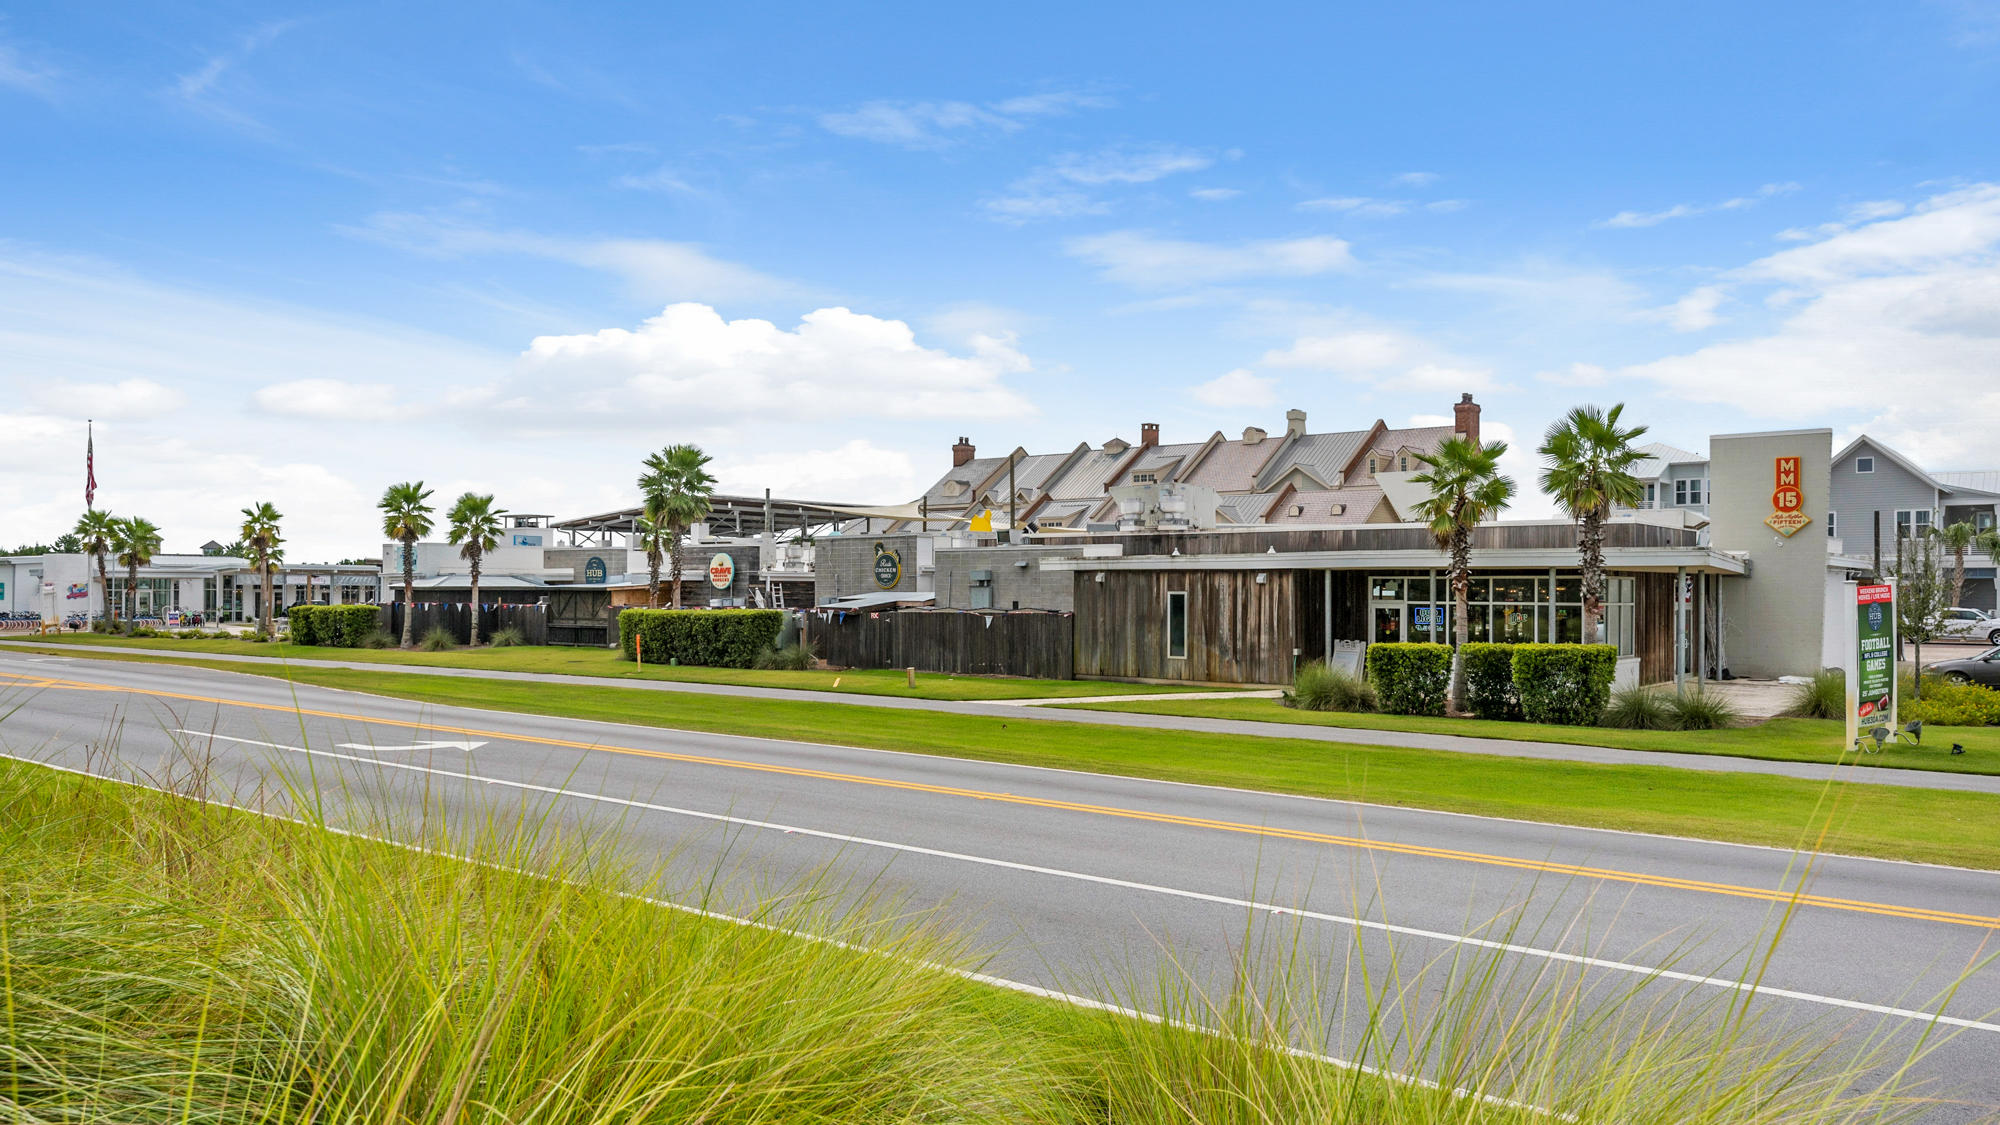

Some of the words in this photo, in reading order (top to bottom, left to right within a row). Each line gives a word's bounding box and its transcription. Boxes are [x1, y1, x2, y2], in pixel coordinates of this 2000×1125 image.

[1777, 492, 1797, 508] 15
[586, 569, 603, 577] HUB
[1869, 612, 1881, 620] HUB
[1861, 637, 1891, 651] FOOTBALL
[1866, 658, 1886, 671] GAMES
